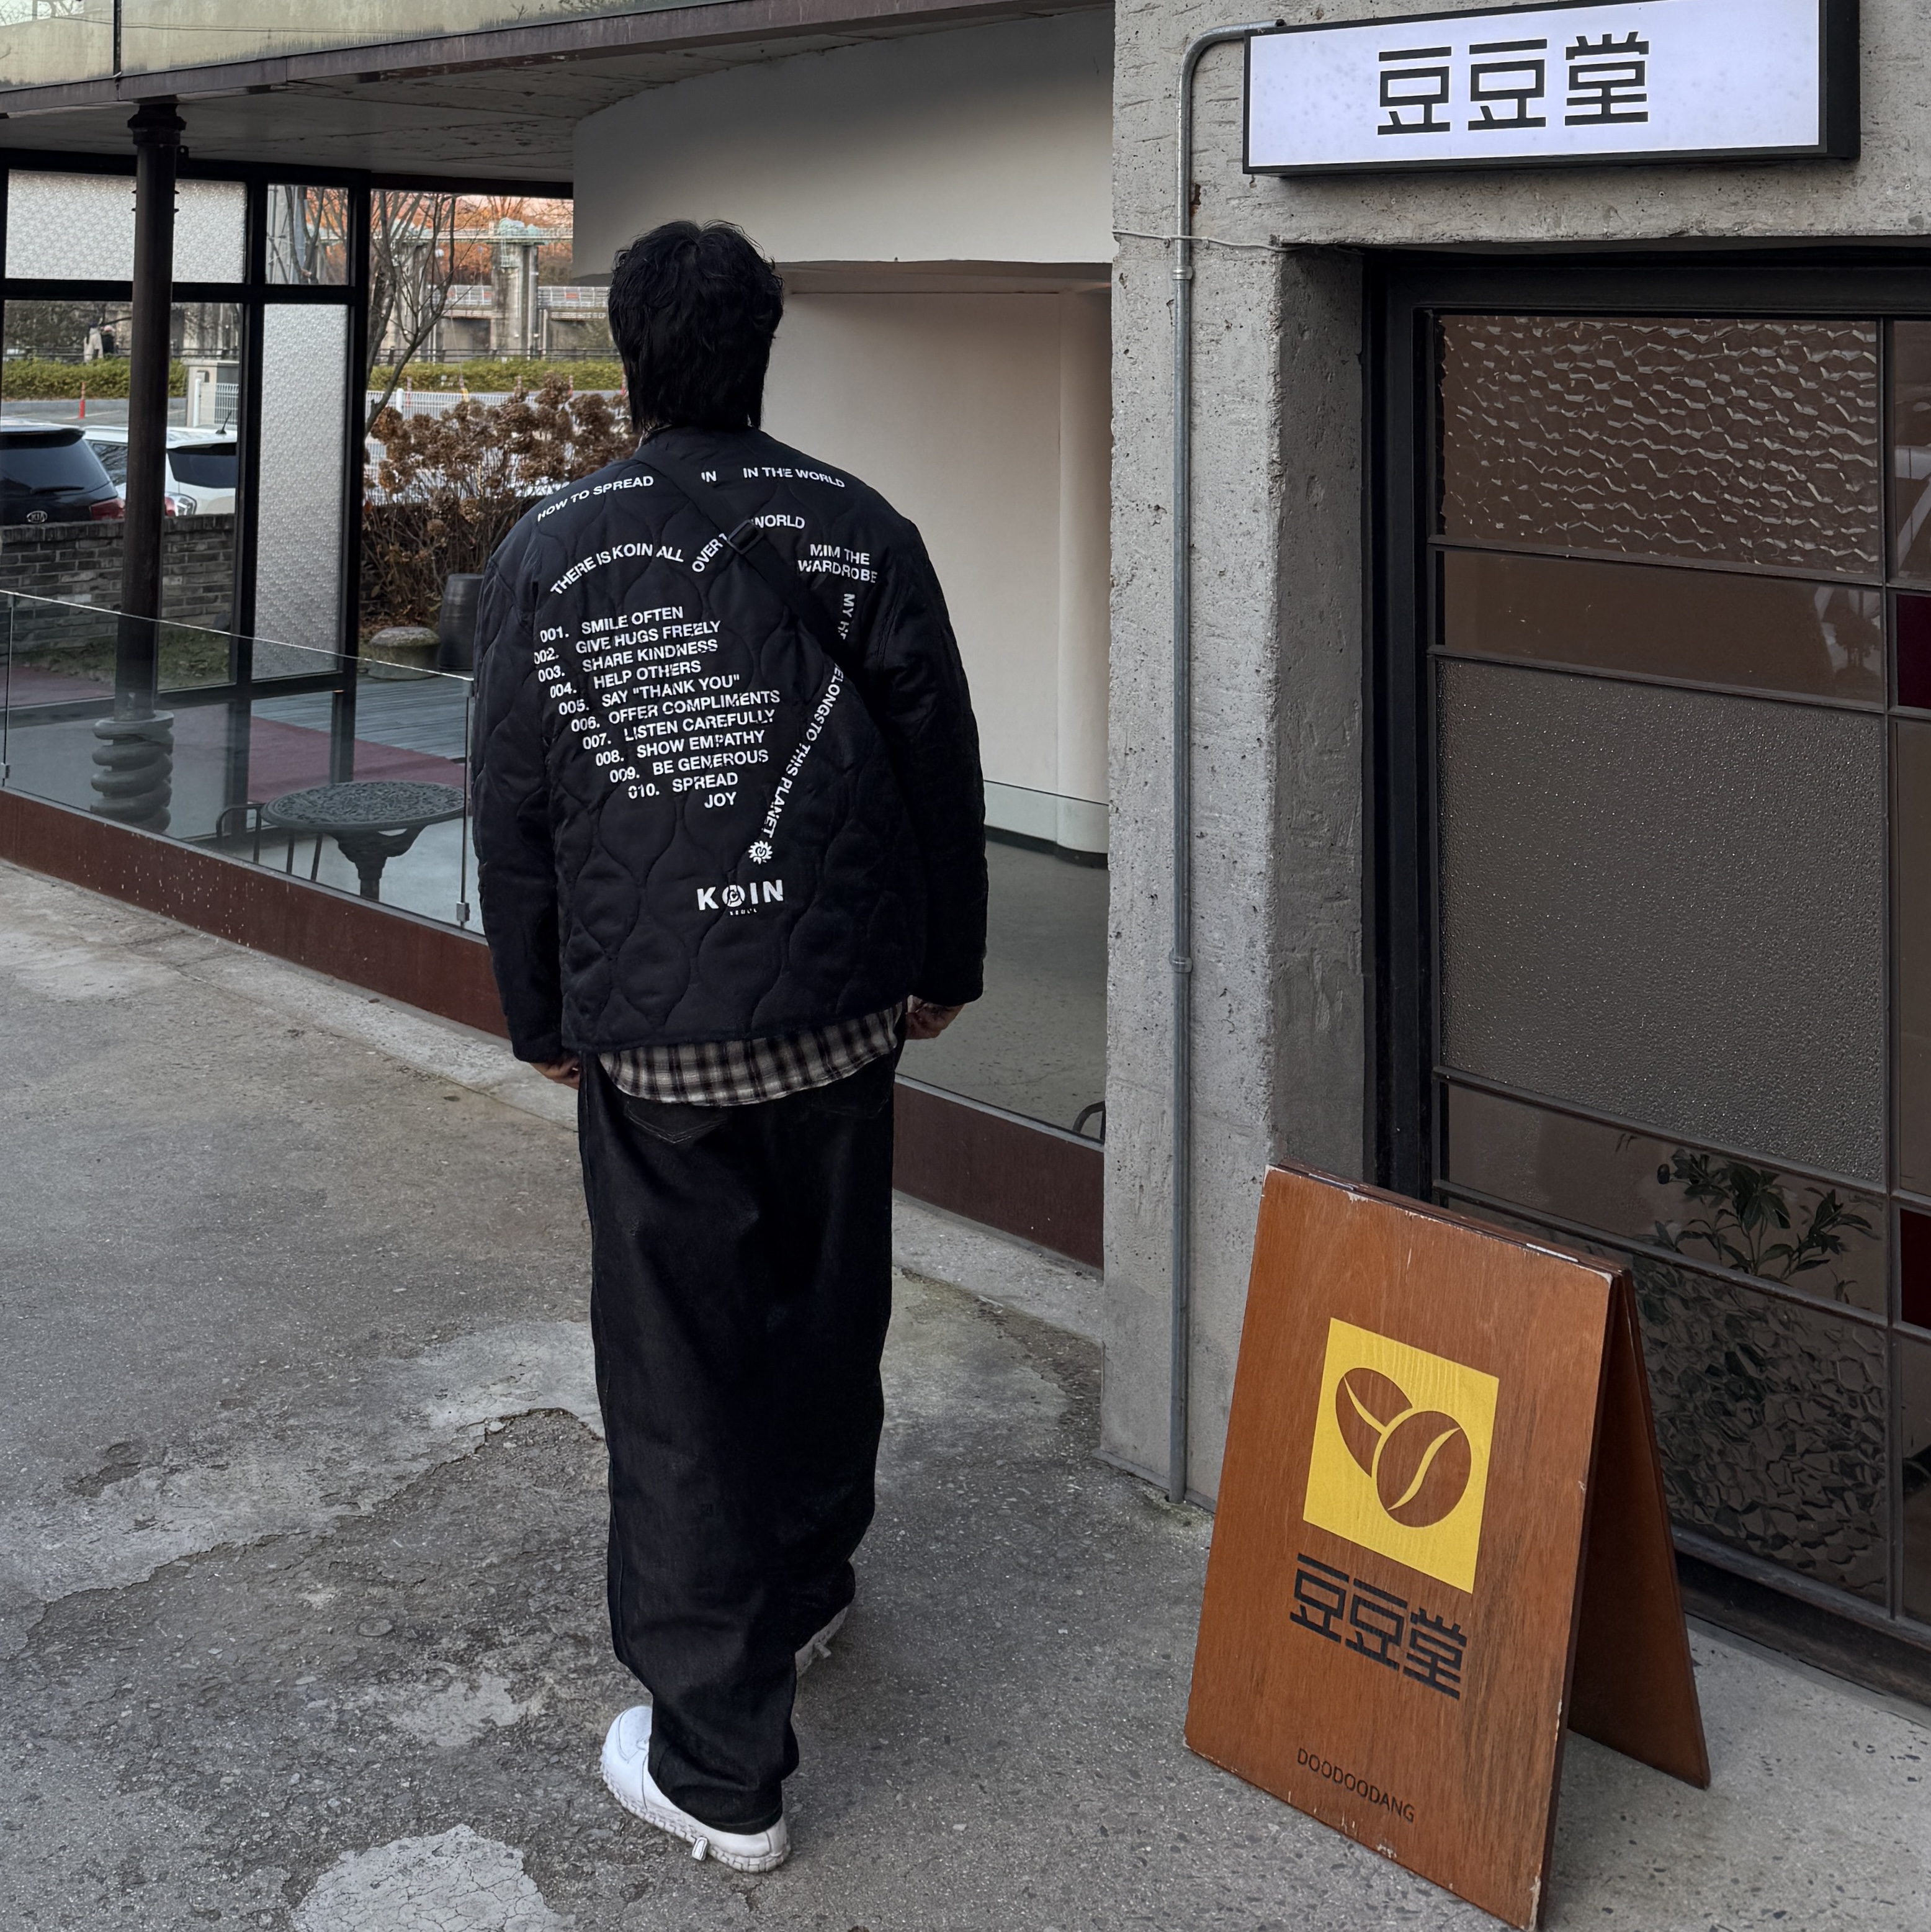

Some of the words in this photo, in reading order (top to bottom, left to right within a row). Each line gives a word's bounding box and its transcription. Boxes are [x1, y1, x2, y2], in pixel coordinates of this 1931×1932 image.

[1377, 31, 1649, 135] 豆豆堂
[537, 498, 568, 522] HOW
[570, 490, 589, 503] TO
[593, 475, 654, 495] SPREAD
[743, 467, 758, 478] IN
[761, 467, 793, 477] THE
[795, 469, 845, 488] WORLD
[550, 556, 597, 595] THERE
[612, 542, 653, 560] KOIN
[656, 546, 684, 563] ALL
[692, 538, 724, 573] OVER
[797, 560, 877, 583] WARDROBE
[810, 544, 840, 558] MIM
[844, 548, 870, 565] THE
[540, 626, 569, 643] 001.
[581, 615, 629, 634] SMILE
[631, 606, 683, 625] OFTEN
[842, 593, 855, 618] MY
[534, 647, 560, 665] 002.
[575, 636, 611, 654] GIVE
[614, 628, 659, 647] HUGS
[662, 620, 721, 639] FREELY
[538, 665, 565, 682] 003.
[582, 650, 634, 672] SHARE
[637, 639, 718, 662] KINDNESS
[550, 682, 577, 698] 004.
[593, 670, 632, 689] HELP
[636, 660, 701, 680] OTHERS
[558, 699, 589, 715] 005.
[601, 690, 628, 707] SAY
[632, 679, 696, 699] "THANK
[698, 673, 740, 691] YOU"
[813, 663, 844, 724] ELONGS
[571, 716, 600, 732] 006.
[608, 704, 658, 724] OFFER
[662, 690, 780, 715] COMPLIMENTS
[582, 732, 611, 750] 007.
[624, 720, 678, 742] LISTEN
[683, 709, 775, 732] CAREFULLY
[595, 749, 624, 766] 008.
[637, 739, 684, 758] SHOW
[689, 729, 765, 750] EMPATHY
[609, 766, 640, 783] 009.
[653, 760, 674, 776] BE
[678, 749, 769, 771] GENEROUS
[786, 743, 811, 776] THIS
[628, 783, 660, 799] 010.
[672, 772, 738, 793] SPREAD
[704, 791, 737, 809] JOY
[761, 777, 792, 838] PLANET
[697, 879, 784, 910] KOIN
[1289, 1552, 1467, 1701] 豆豆堂
[1297, 1747, 1415, 1823] DOODOODANG
